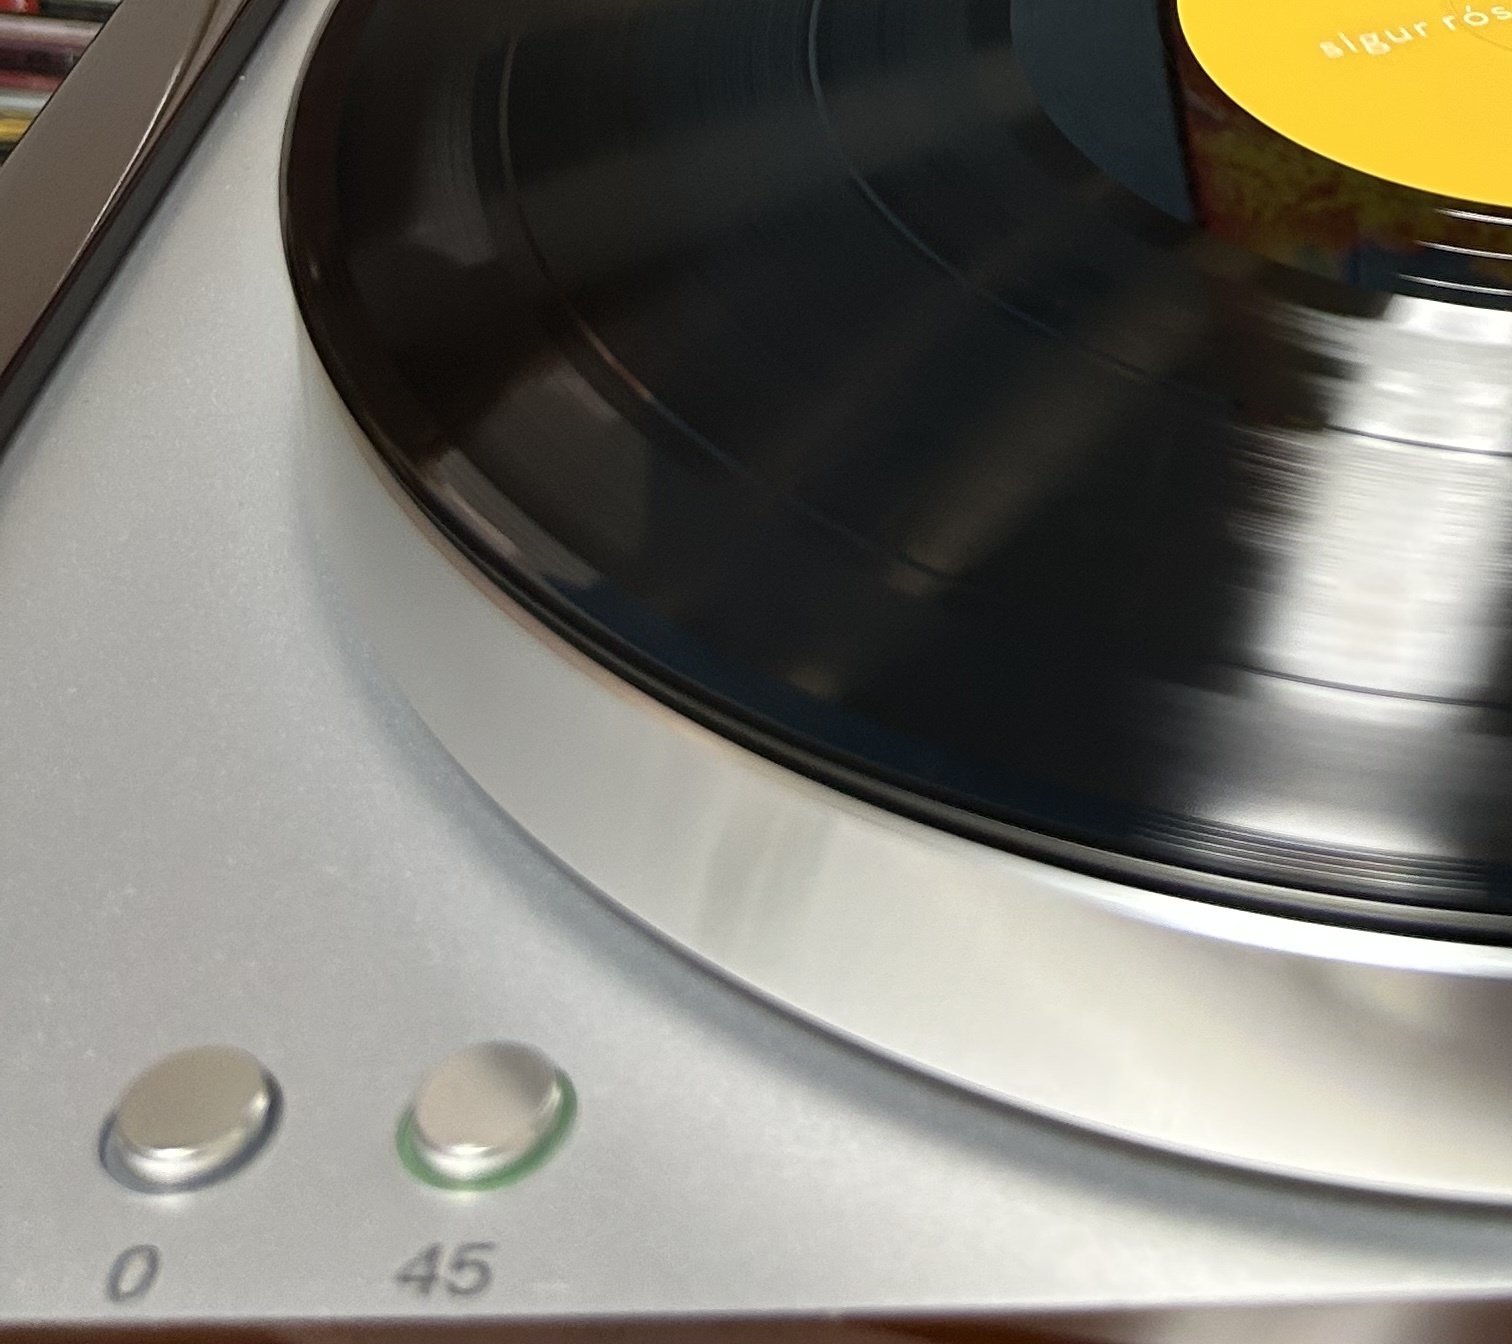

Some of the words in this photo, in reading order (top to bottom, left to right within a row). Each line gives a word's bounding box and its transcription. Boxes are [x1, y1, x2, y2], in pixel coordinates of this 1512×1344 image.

[1319, 20, 1430, 60] sigur
[104, 1242, 162, 1304] 0
[393, 1238, 500, 1298] 45
